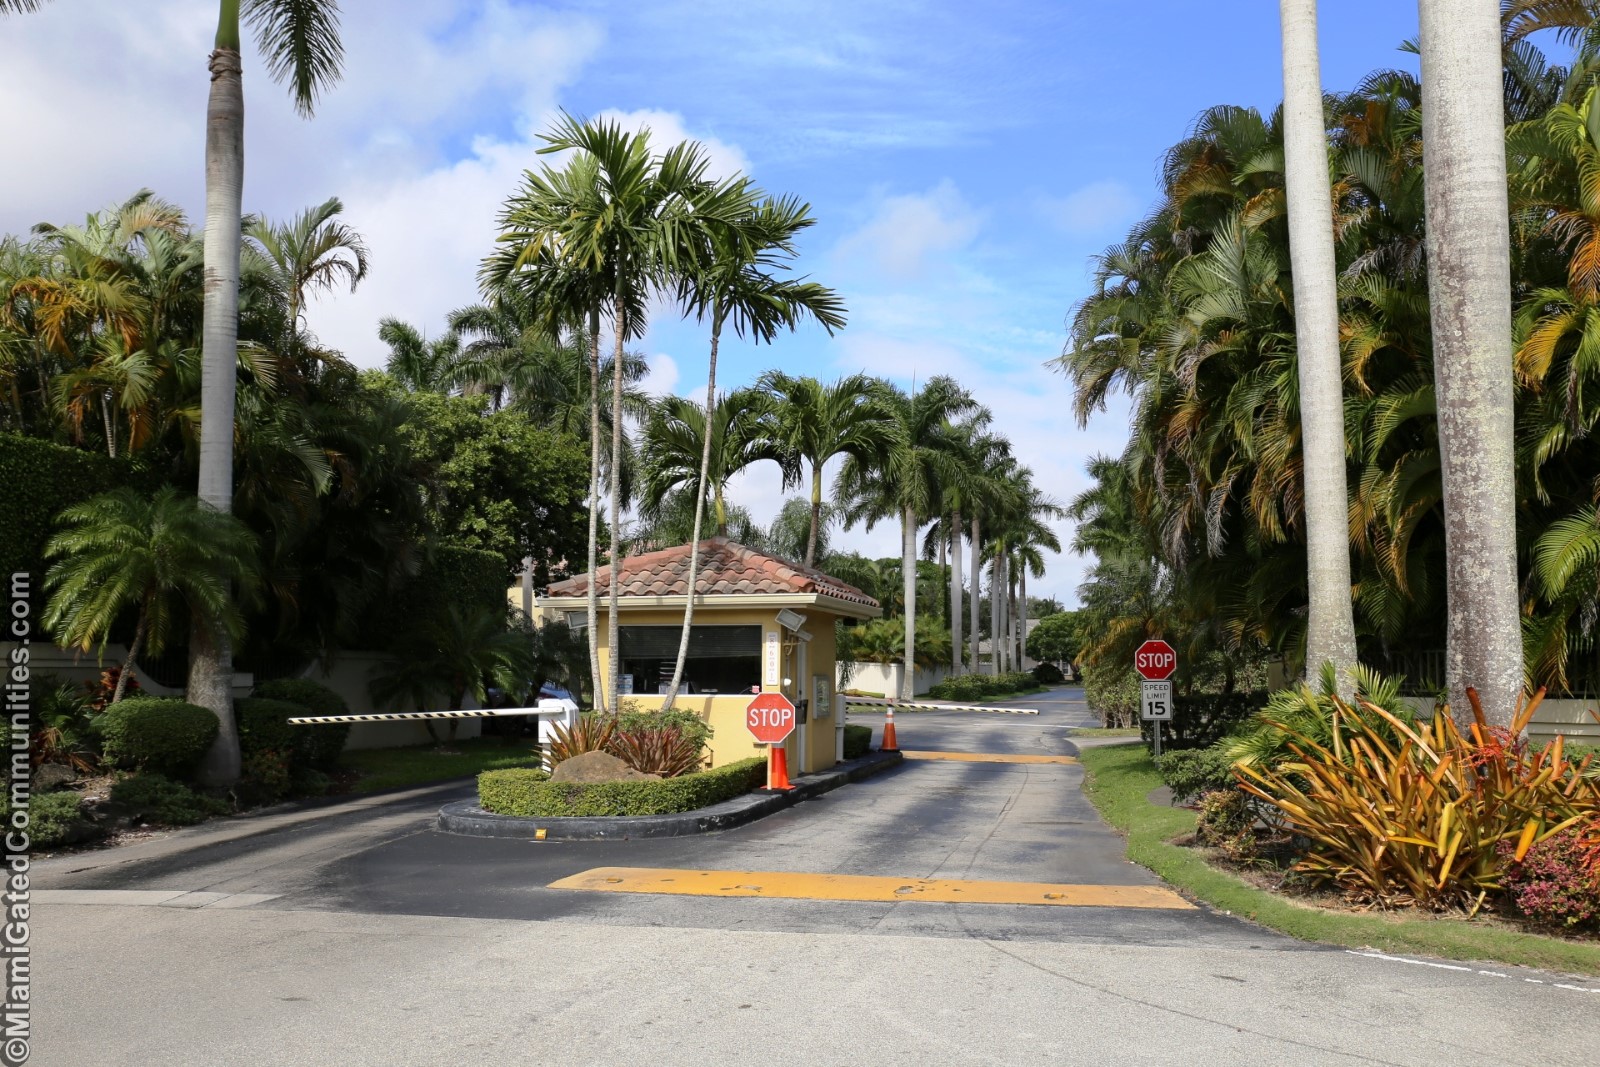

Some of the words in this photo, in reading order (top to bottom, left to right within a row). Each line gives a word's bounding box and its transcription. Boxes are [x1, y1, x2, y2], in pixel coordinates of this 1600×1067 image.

[1138, 653, 1173, 668] STOP
[1148, 701, 1166, 715] 15
[749, 708, 792, 727] STOP
